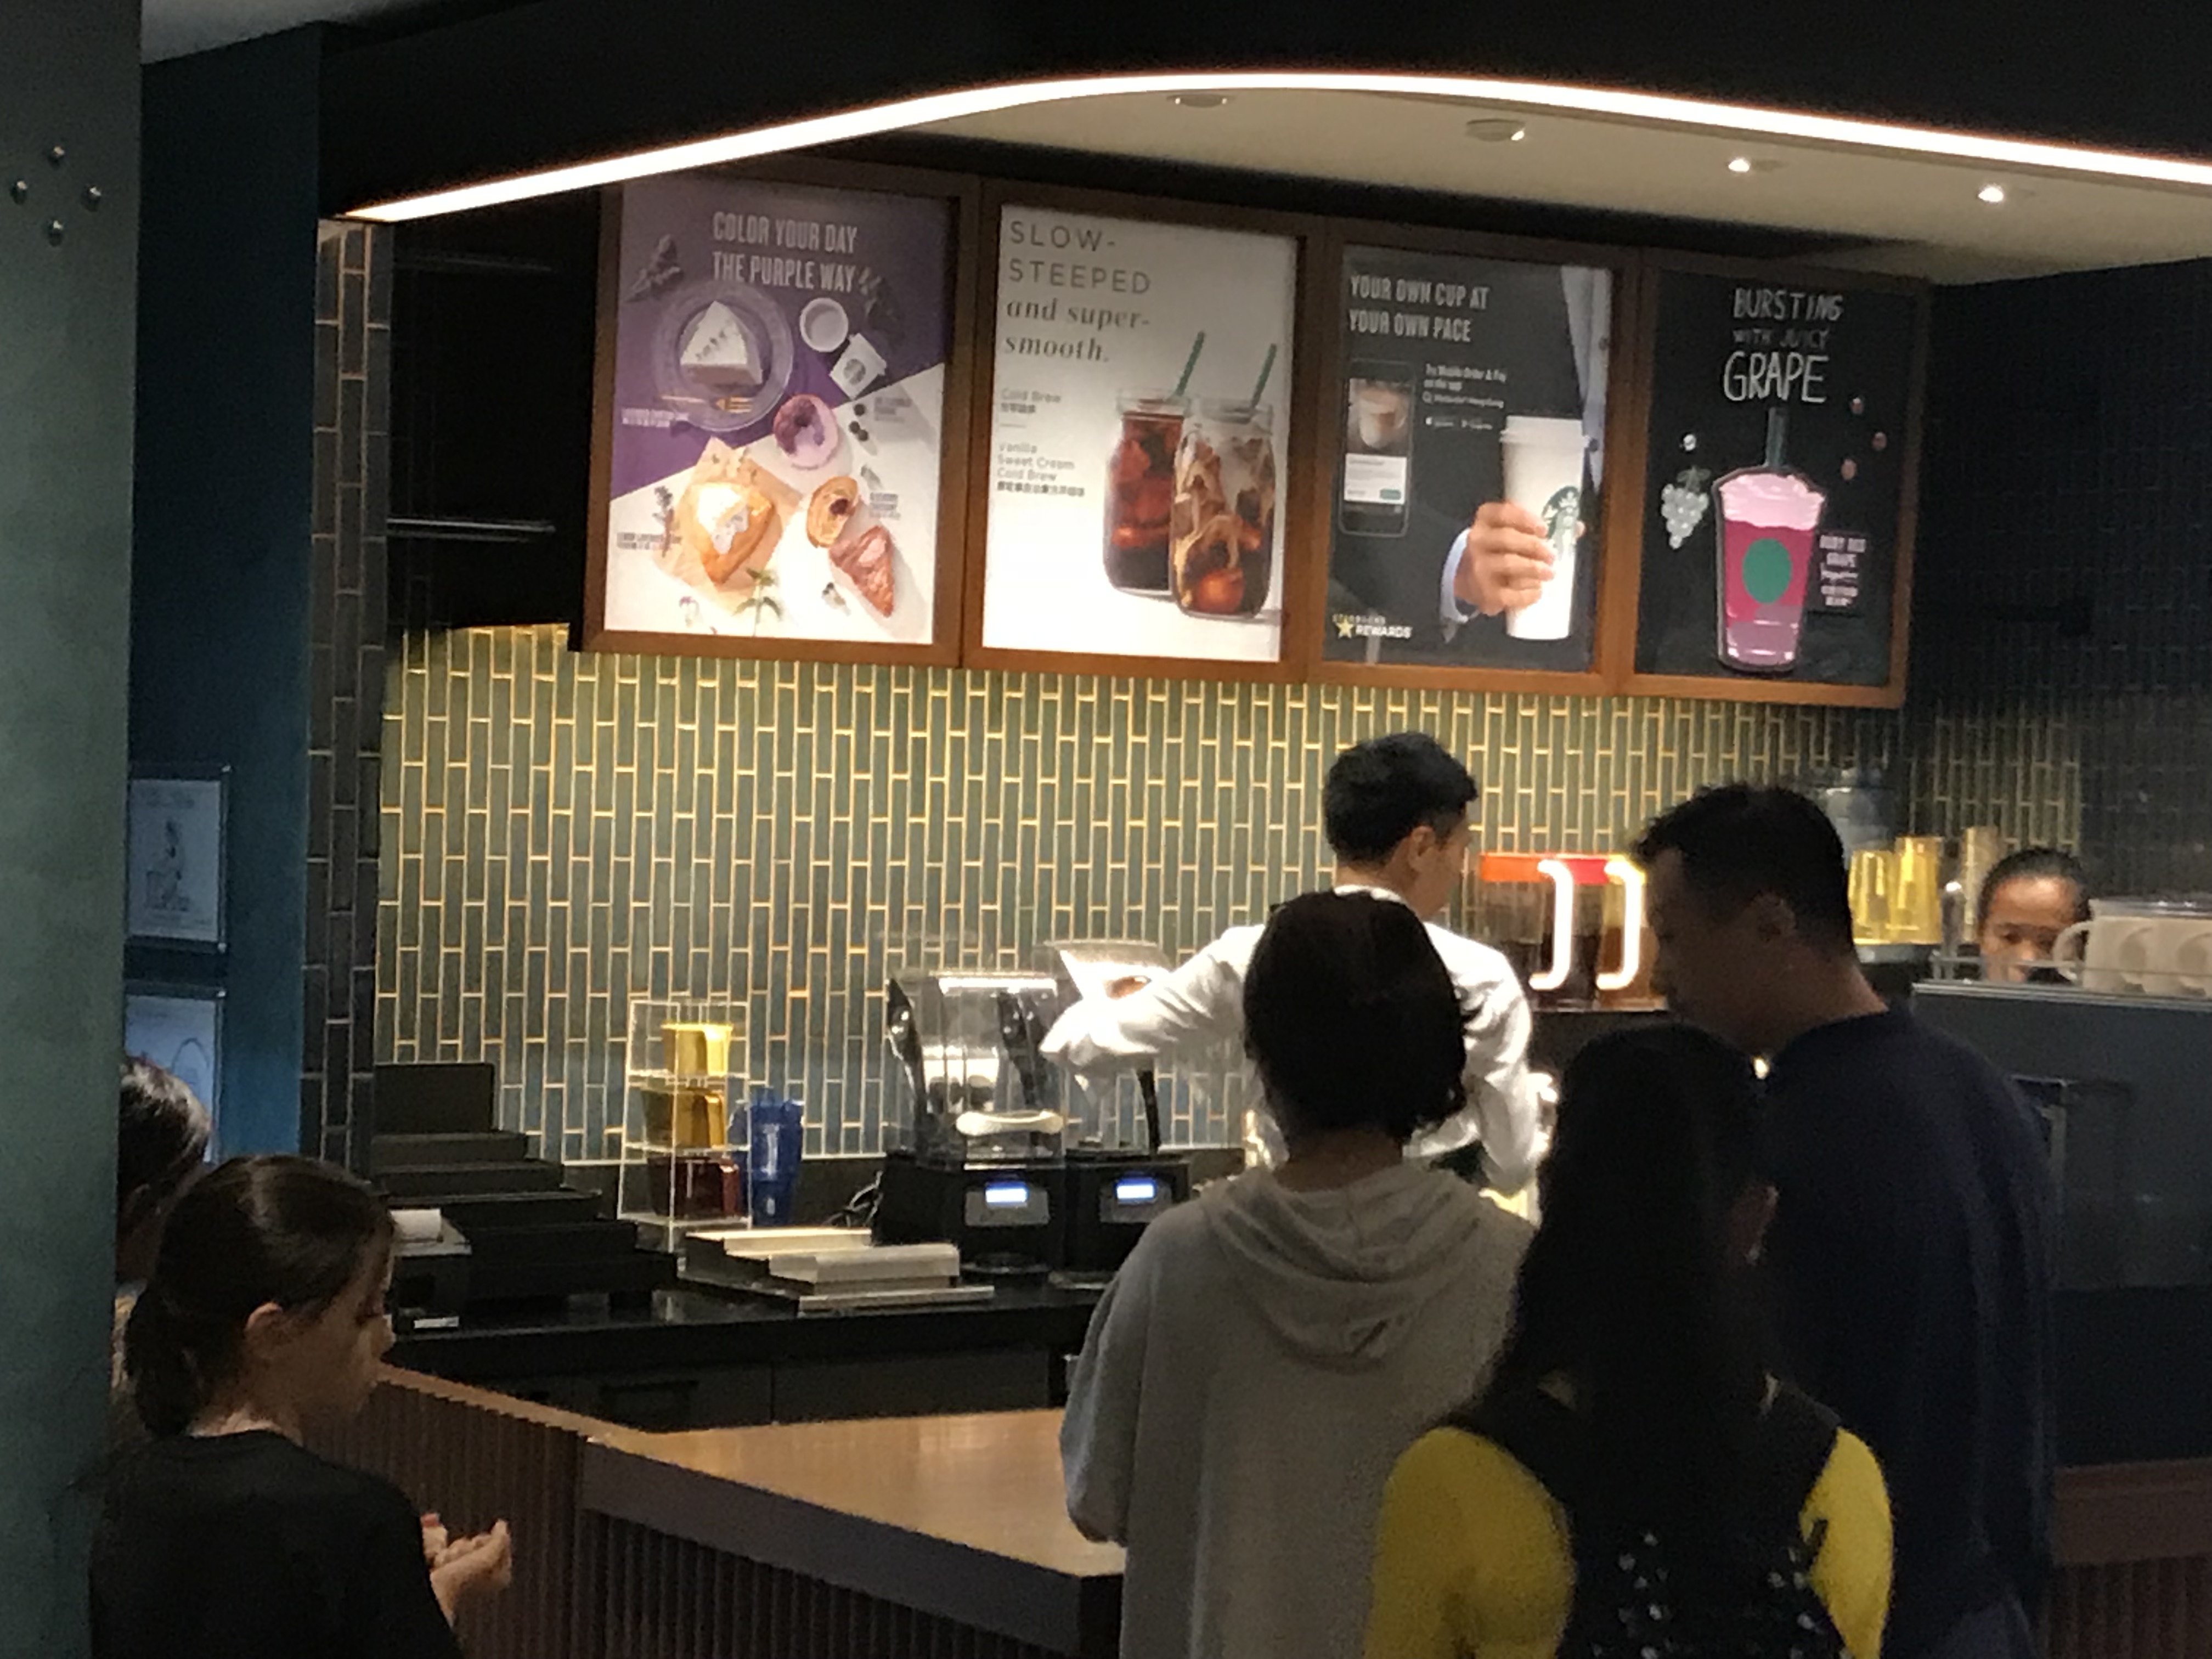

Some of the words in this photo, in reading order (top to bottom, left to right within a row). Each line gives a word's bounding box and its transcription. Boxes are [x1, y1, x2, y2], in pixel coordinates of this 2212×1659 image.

[714, 211, 769, 245] COLOR
[775, 219, 820, 250] YOUR
[825, 224, 857, 253] DAY
[1010, 221, 1115, 252] SLOW-
[713, 251, 744, 282] THE
[750, 255, 815, 290] PURPLE
[820, 263, 855, 293] WAY
[1008, 257, 1150, 295] STEEPED
[1350, 274, 1392, 301] YOUR
[1396, 278, 1432, 304] OWN
[1435, 283, 1466, 308] CUP
[1469, 286, 1491, 310] AT
[1734, 287, 1844, 321] BURSTING
[1006, 297, 1058, 321] and
[1068, 306, 1150, 331] super-
[1349, 309, 1390, 335] YOUR
[1394, 312, 1430, 337] OWN
[1432, 315, 1472, 343] PACE
[1005, 336, 1109, 363] smooth.
[1723, 350, 1830, 403] GRAPE
[1355, 624, 1413, 640] REWARDS
